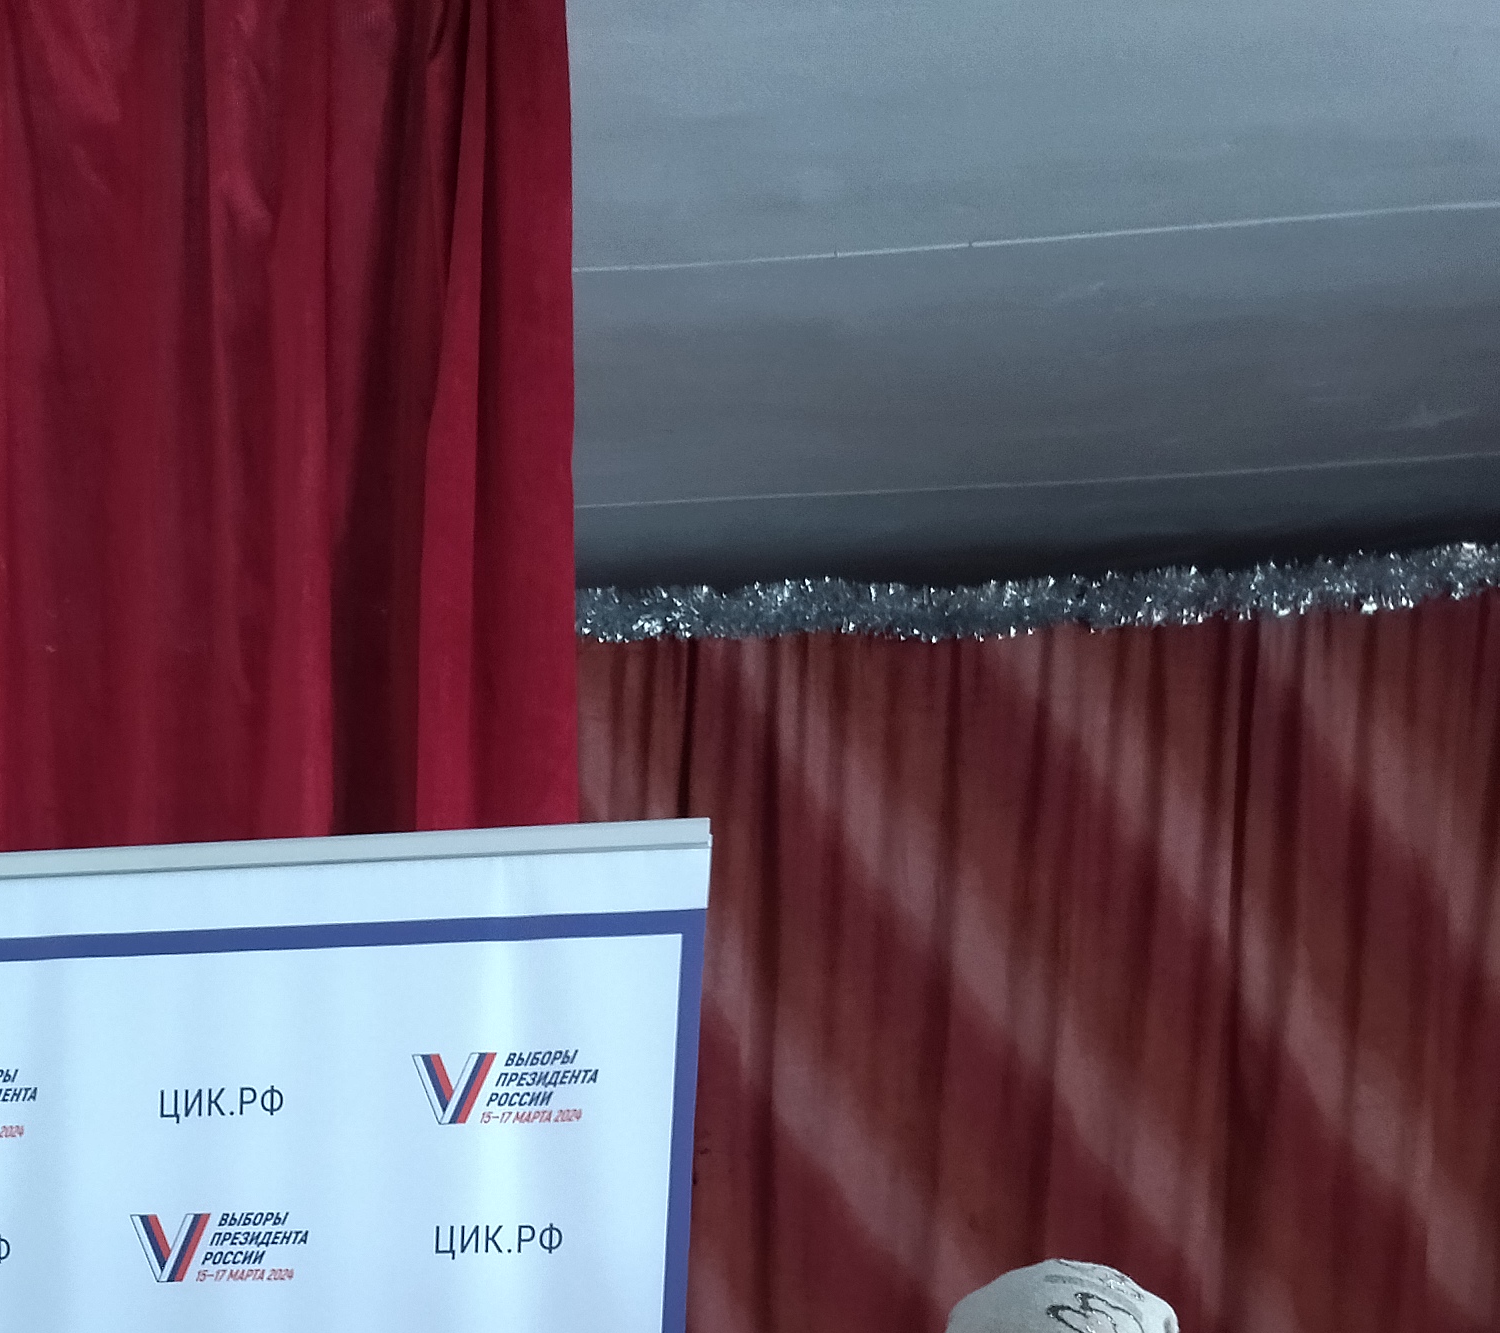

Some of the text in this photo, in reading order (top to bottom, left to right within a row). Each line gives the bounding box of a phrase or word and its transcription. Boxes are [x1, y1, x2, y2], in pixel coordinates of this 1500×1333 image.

[504, 1050, 578, 1066] ВЫБОРЫ
[495, 1069, 599, 1087] ПРЕЗИДЕНТА
[160, 1085, 283, 1124] ЦИК.РФ
[486, 1091, 553, 1106] РОССИИ
[513, 1110, 553, 1123] МАРТА
[553, 1109, 582, 1123] 2024
[218, 1212, 289, 1226] ВЫБОРЫ
[210, 1230, 308, 1247] ПРЕЗИДЕНТА
[435, 1223, 562, 1260] ЦИК.РФ
[201, 1251, 266, 1265] РОССИИ
[226, 1269, 265, 1281] МАРТА
[266, 1269, 294, 1280] 2024
